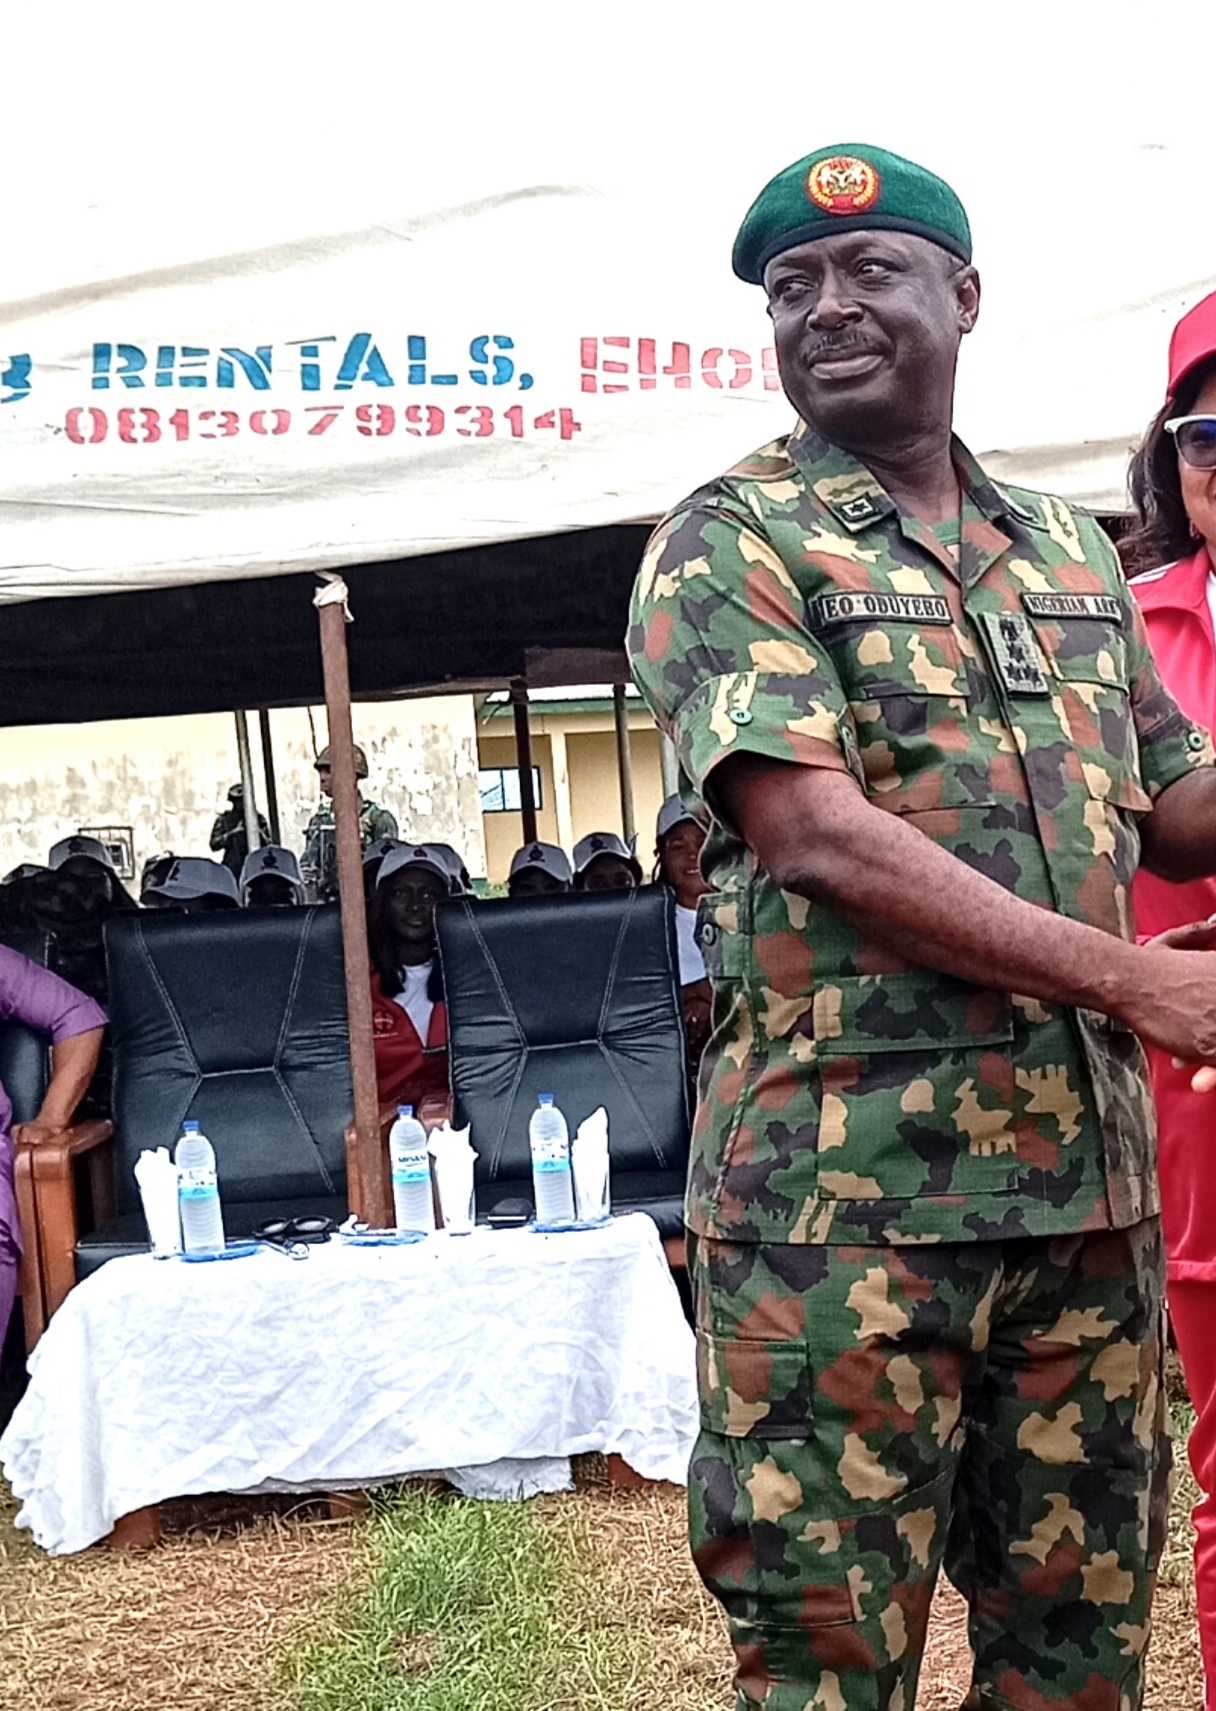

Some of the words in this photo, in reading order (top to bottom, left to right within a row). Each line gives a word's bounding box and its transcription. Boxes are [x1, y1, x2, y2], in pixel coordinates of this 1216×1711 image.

[91, 332, 534, 391] RENTALS,
[64, 404, 582, 445] 08130799314
[863, 596, 947, 618] ODUYEBO
[1027, 596, 1090, 615] NIGERIAN
